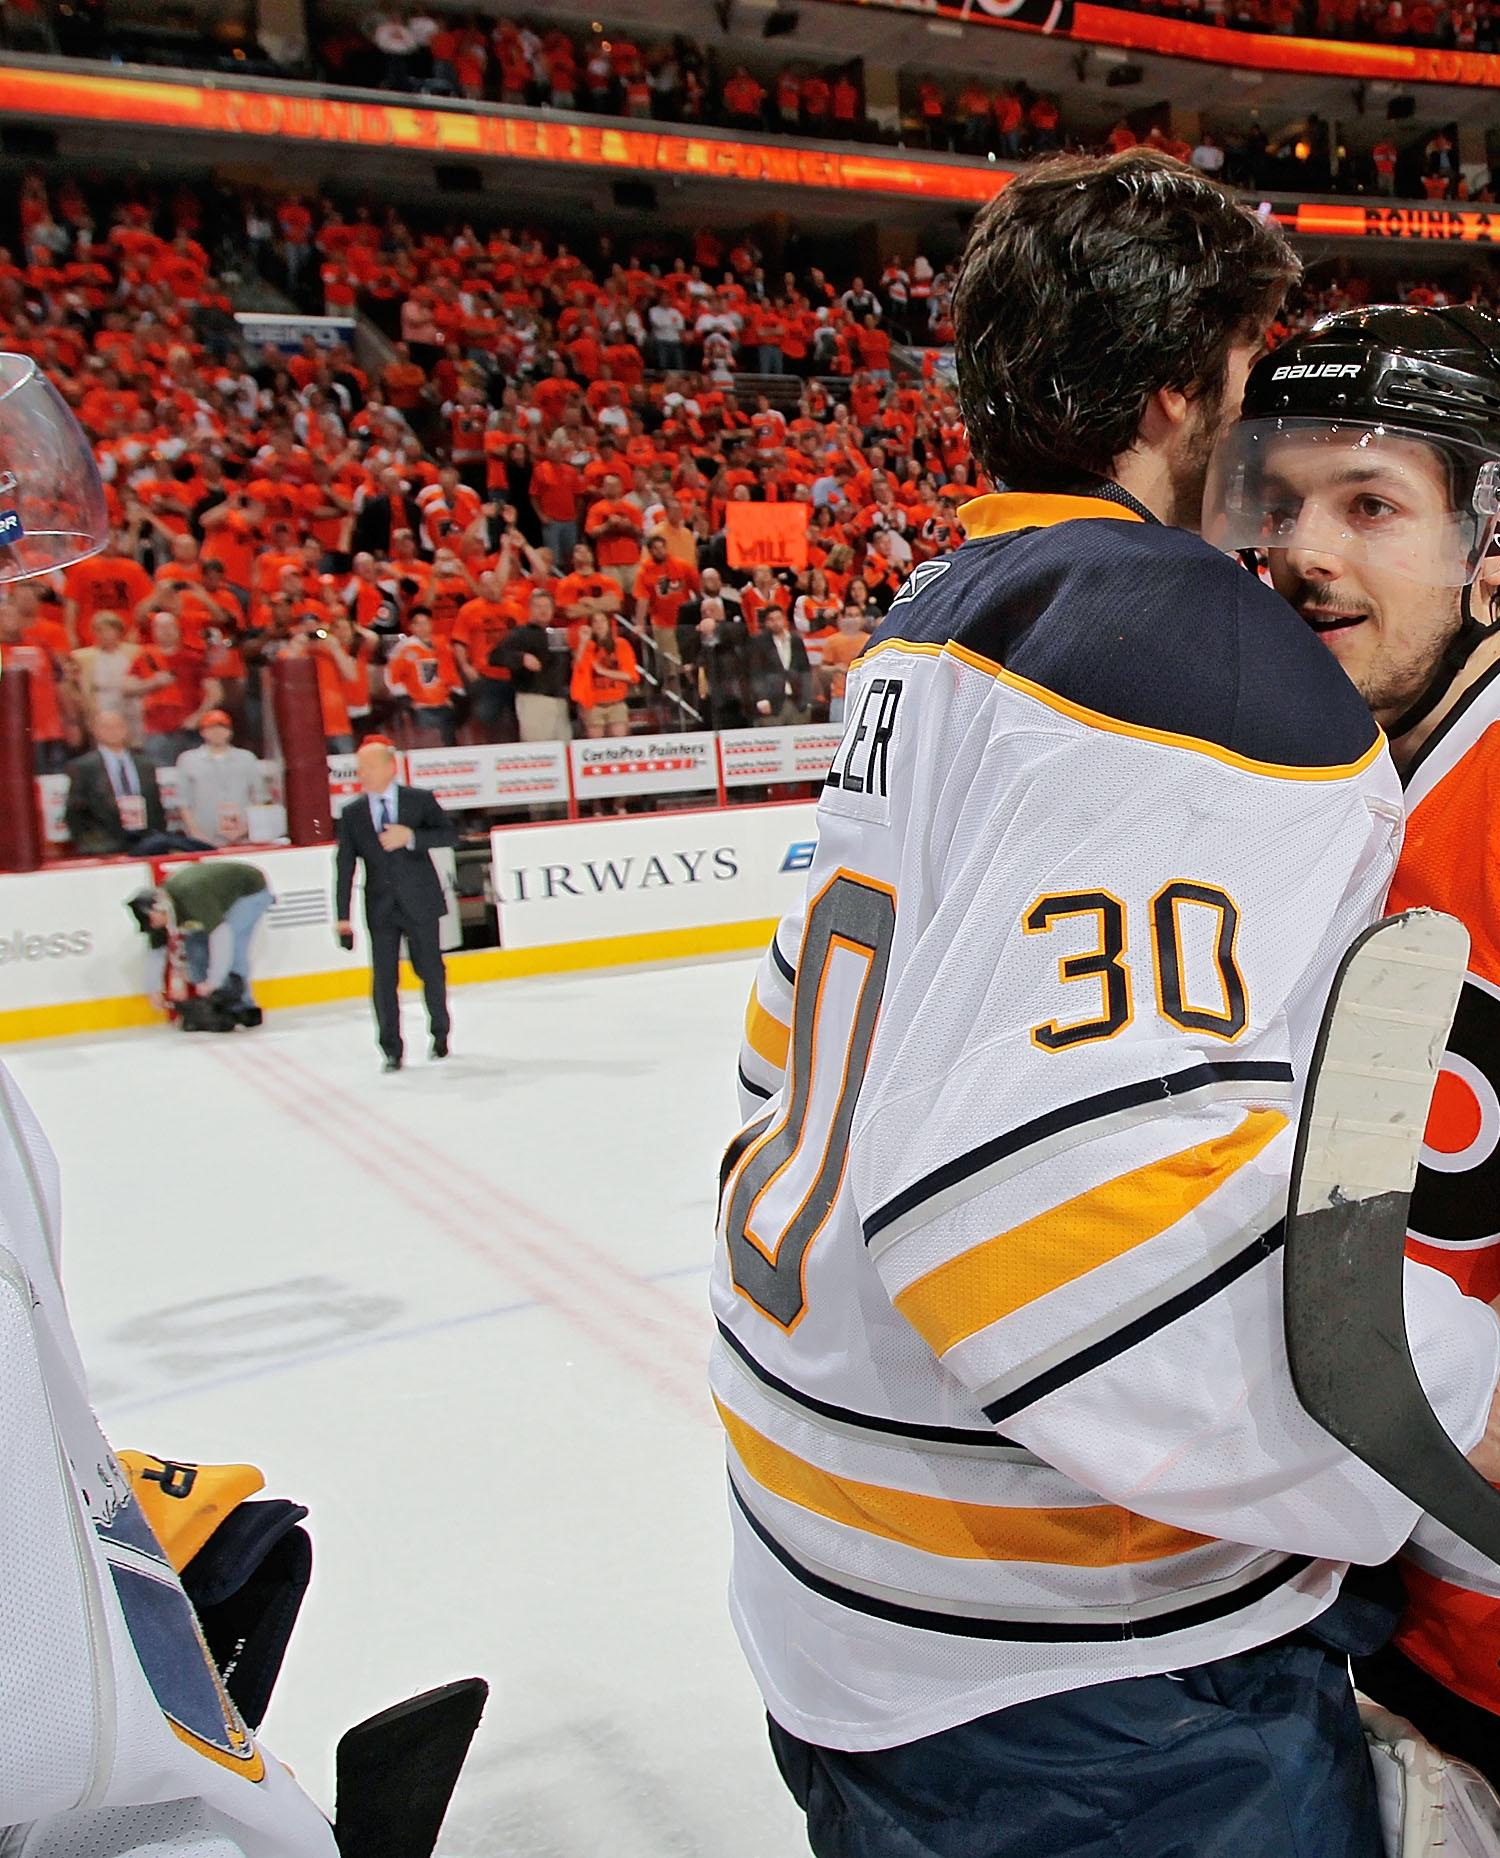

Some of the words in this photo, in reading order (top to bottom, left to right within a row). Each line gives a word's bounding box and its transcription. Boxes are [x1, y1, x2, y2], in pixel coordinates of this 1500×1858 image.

[1271, 363, 1362, 381] BAUER
[498, 847, 738, 903] IRWAYS
[1021, 878, 1249, 1054] 30
